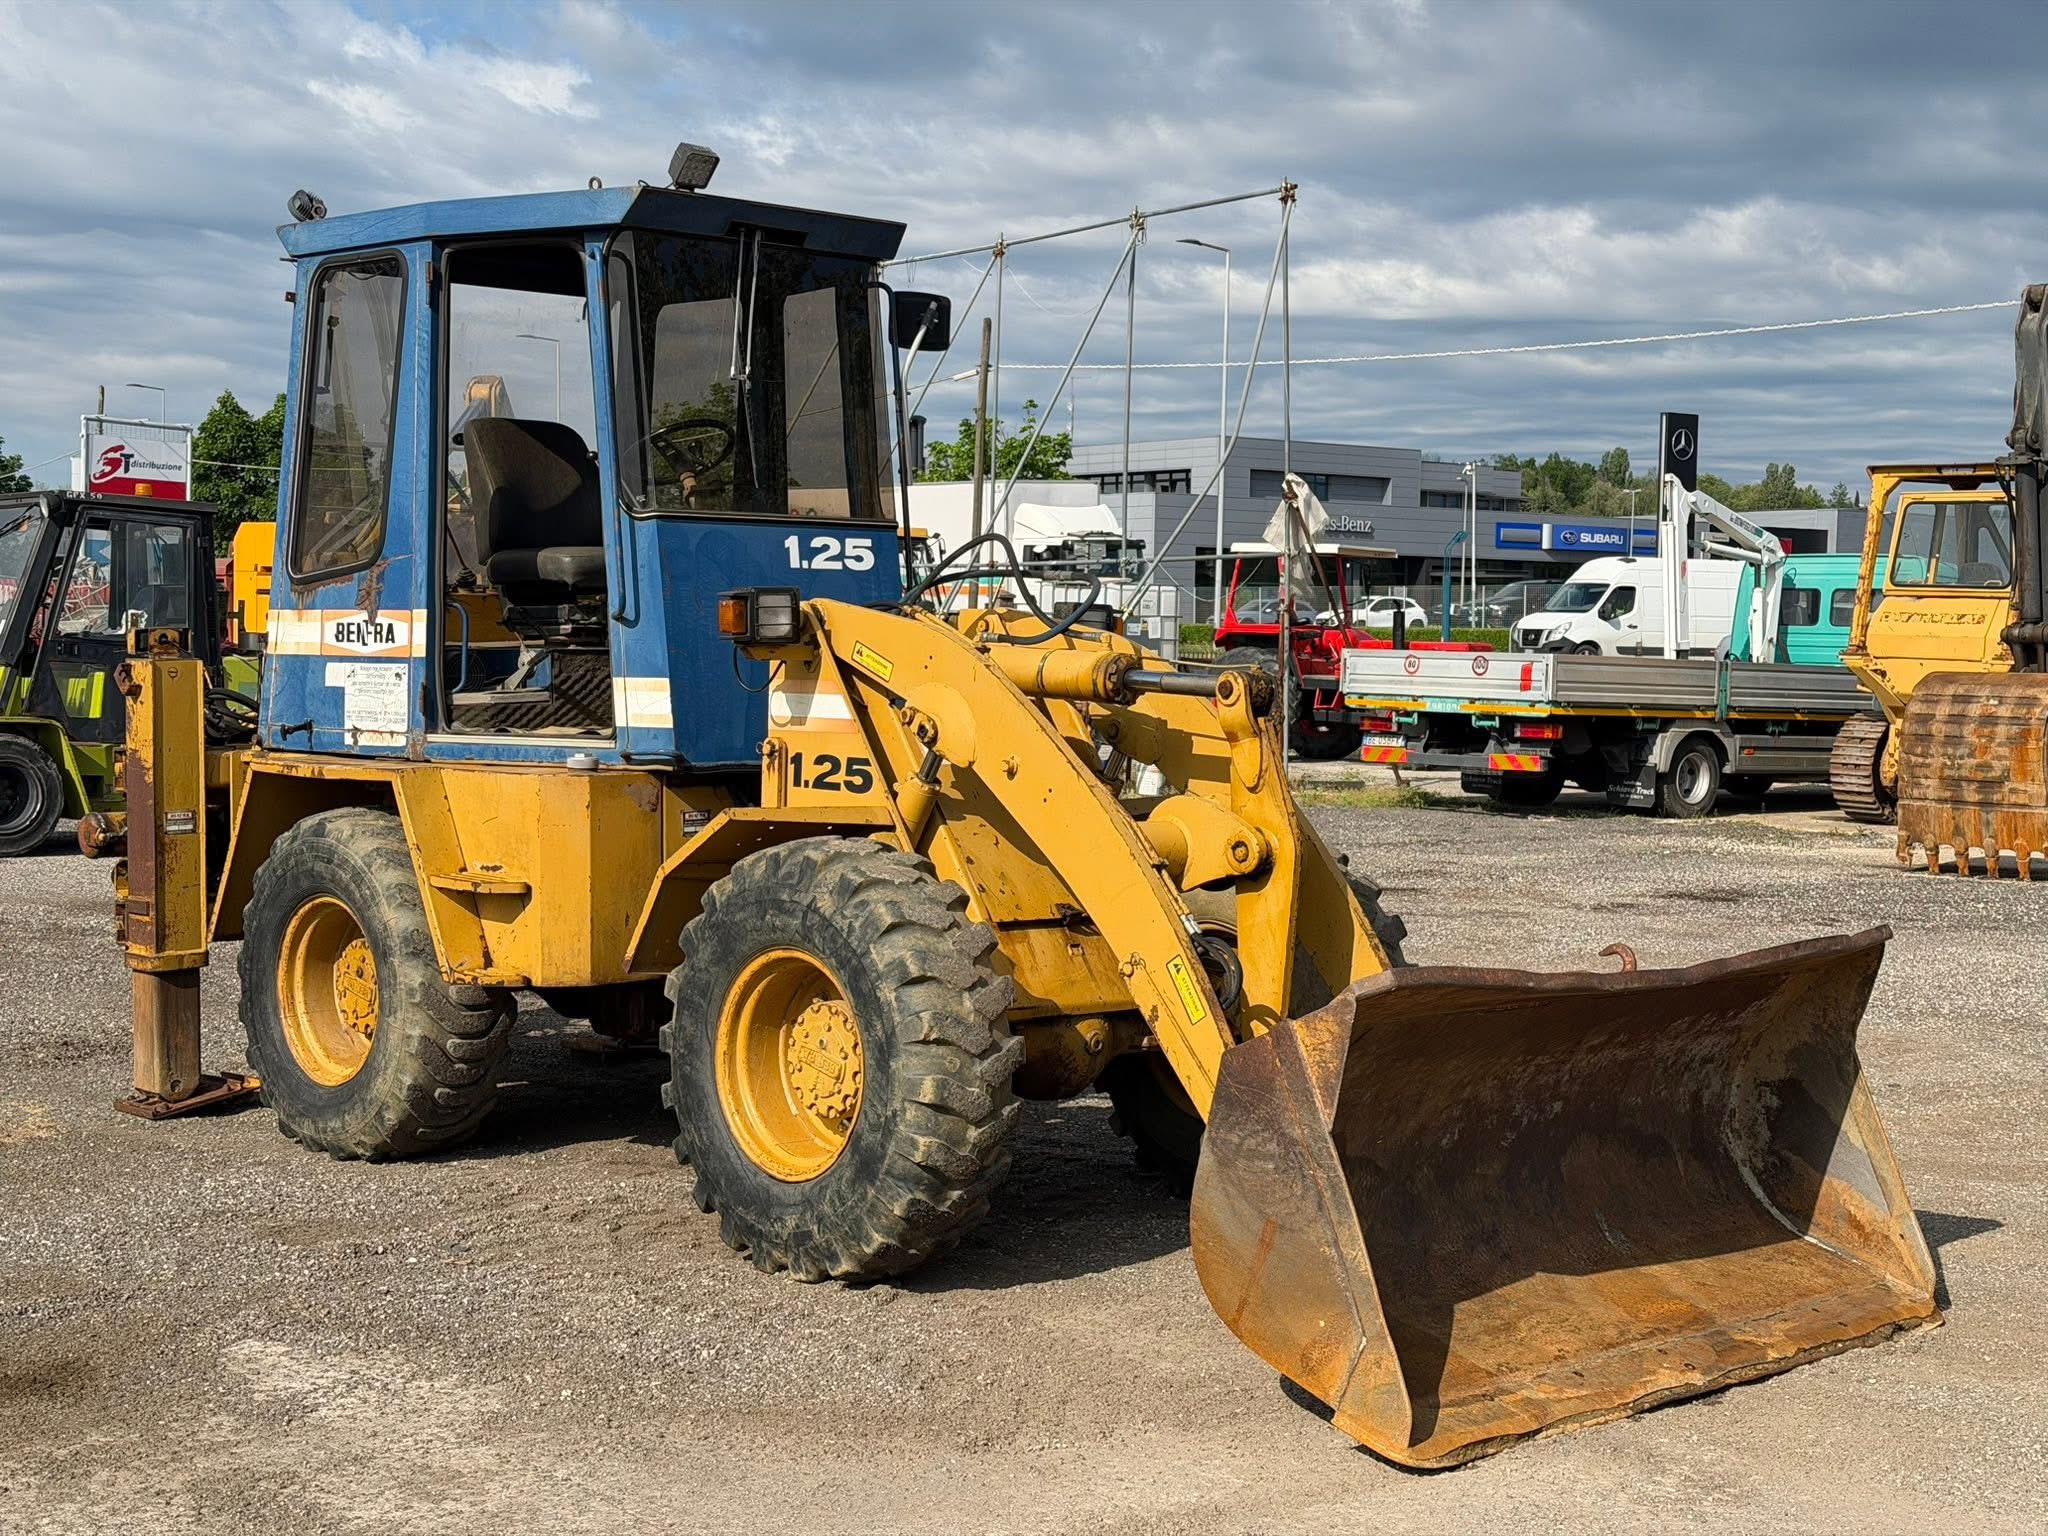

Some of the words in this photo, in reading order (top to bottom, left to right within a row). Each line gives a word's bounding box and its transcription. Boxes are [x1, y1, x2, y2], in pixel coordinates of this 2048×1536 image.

[131, 460, 183, 472] distribuzione
[1580, 532, 1624, 545] SUBARU
[784, 535, 875, 571] 1.25
[335, 620, 396, 646] BENFRA
[789, 751, 874, 794] 1.25
